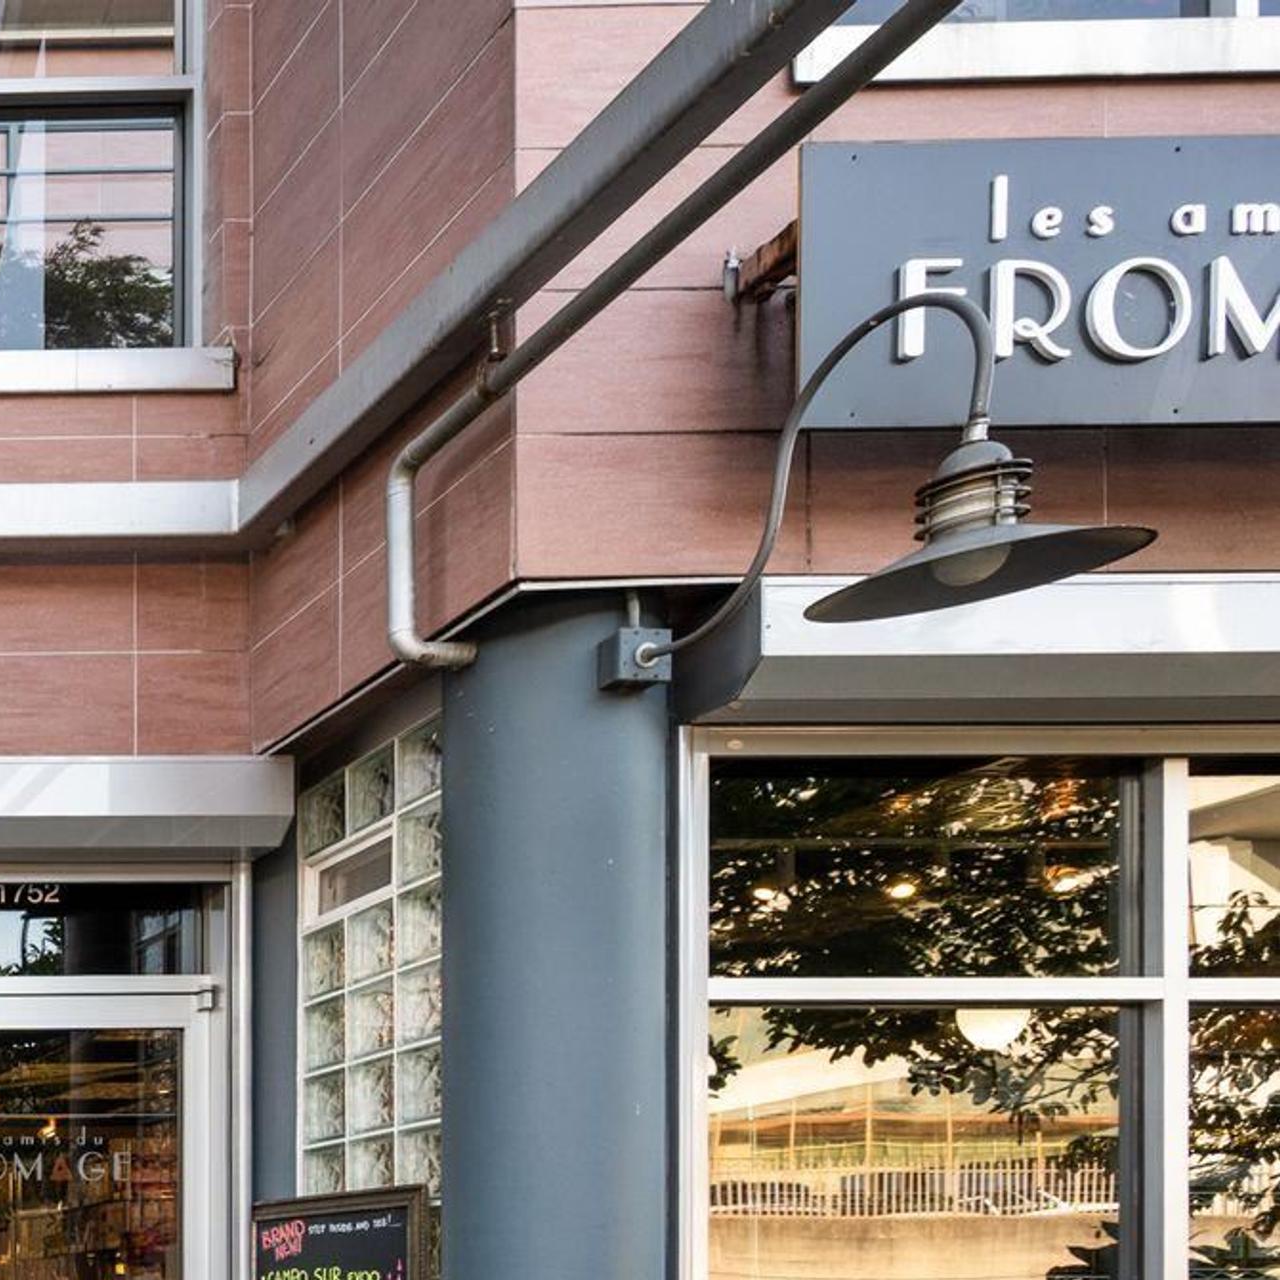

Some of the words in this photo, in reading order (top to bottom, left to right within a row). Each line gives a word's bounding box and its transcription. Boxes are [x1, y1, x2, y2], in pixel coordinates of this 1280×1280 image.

[989, 174, 1114, 242] les
[1169, 201, 1280, 237] am
[896, 256, 1280, 362] FROM
[2, 1132, 61, 1146] amis
[76, 1126, 104, 1146] du
[262, 1219, 305, 1249] BRAND
